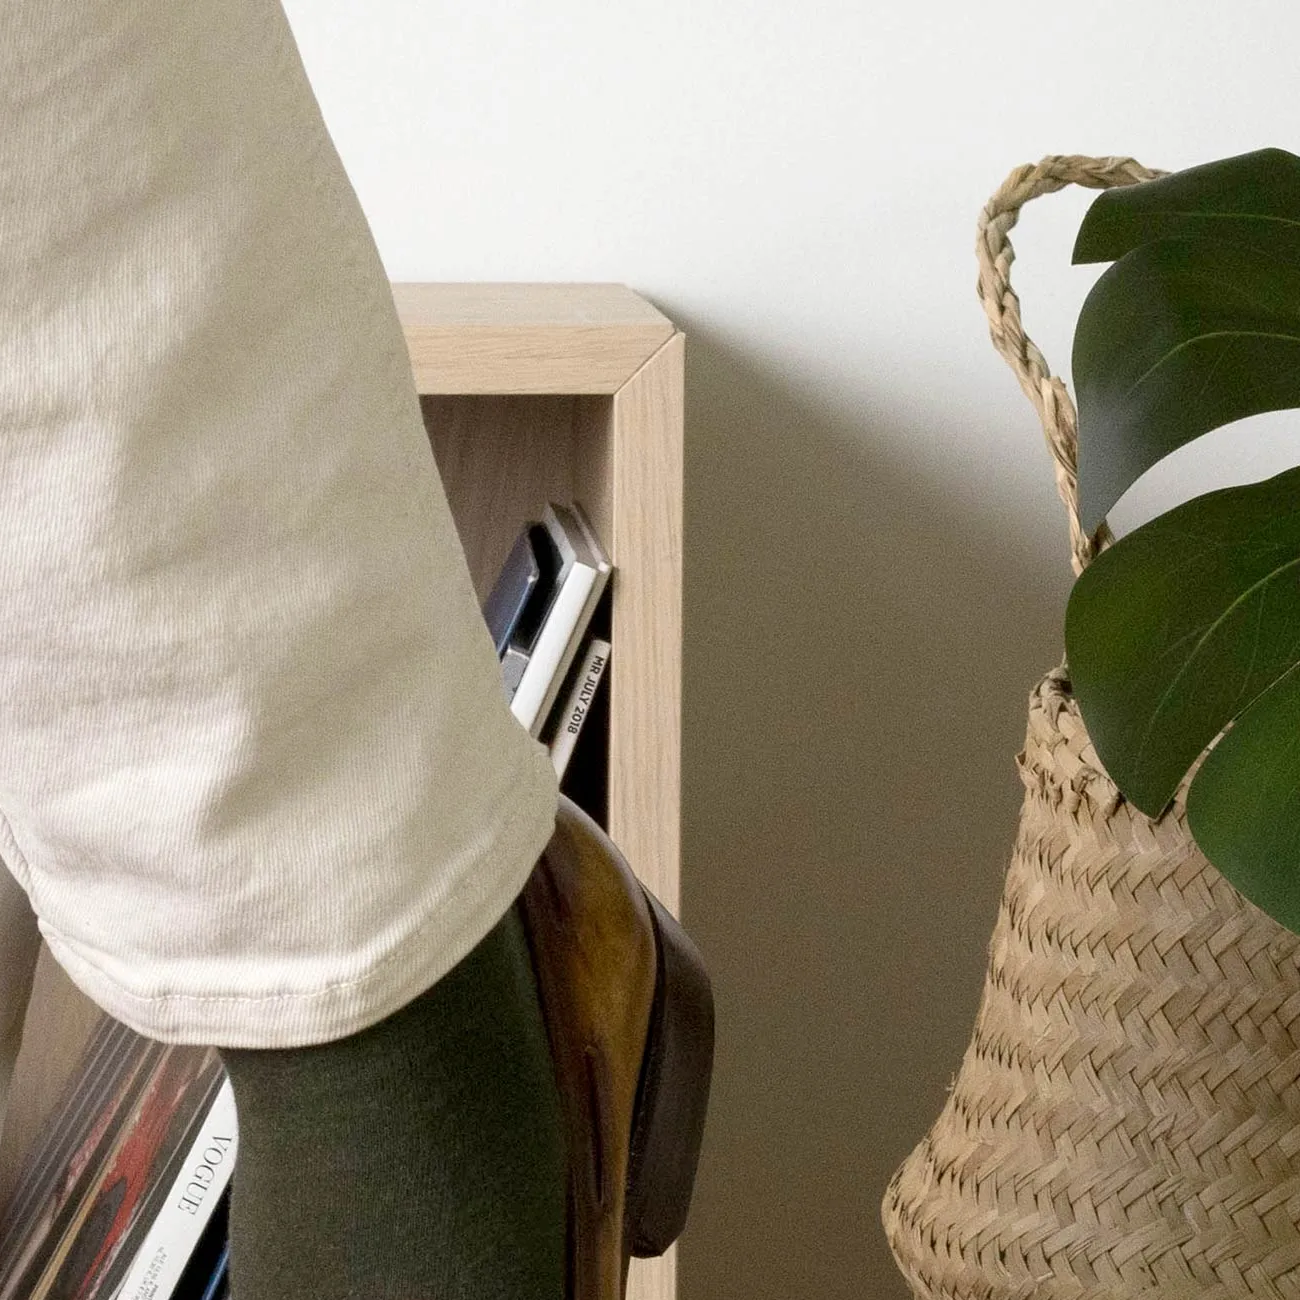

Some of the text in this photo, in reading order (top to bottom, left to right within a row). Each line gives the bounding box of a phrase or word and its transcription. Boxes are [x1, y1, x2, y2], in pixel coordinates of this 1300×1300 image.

[565, 654, 605, 735] MR JULY 2018
[177, 1132, 233, 1216] VOGUE
